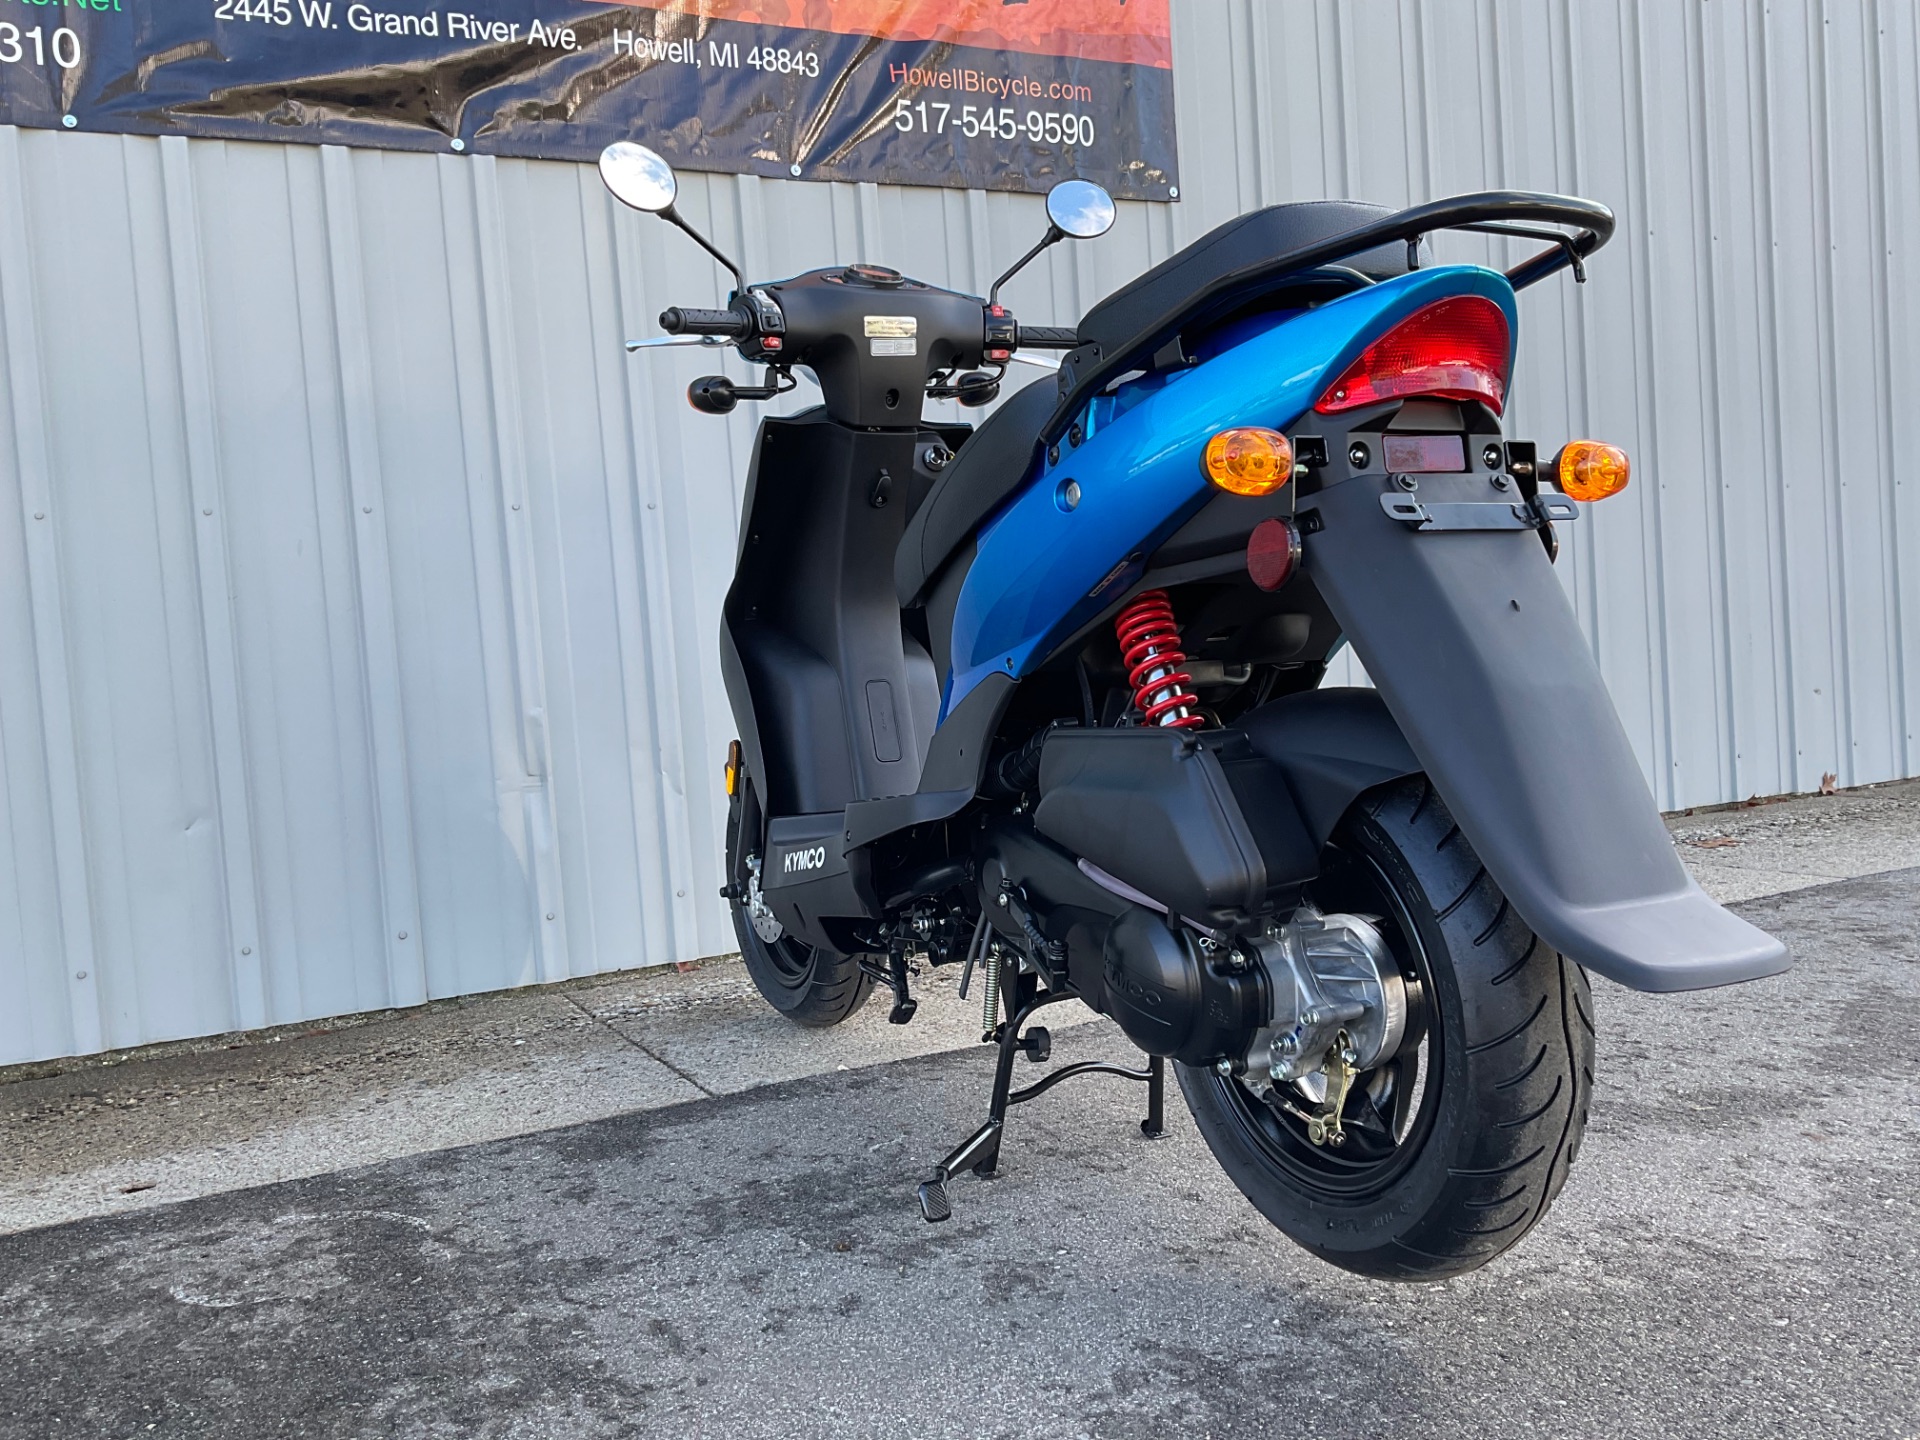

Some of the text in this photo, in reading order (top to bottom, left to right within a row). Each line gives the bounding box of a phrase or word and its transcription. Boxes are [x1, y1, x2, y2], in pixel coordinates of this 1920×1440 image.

[214, 0, 820, 78] 2445 W. Grand River Ave. Howell, MI 48843
[889, 62, 1092, 102] HowellBicycle.com
[895, 99, 1095, 148] 517-545-9590
[784, 846, 826, 873] KYMCO
